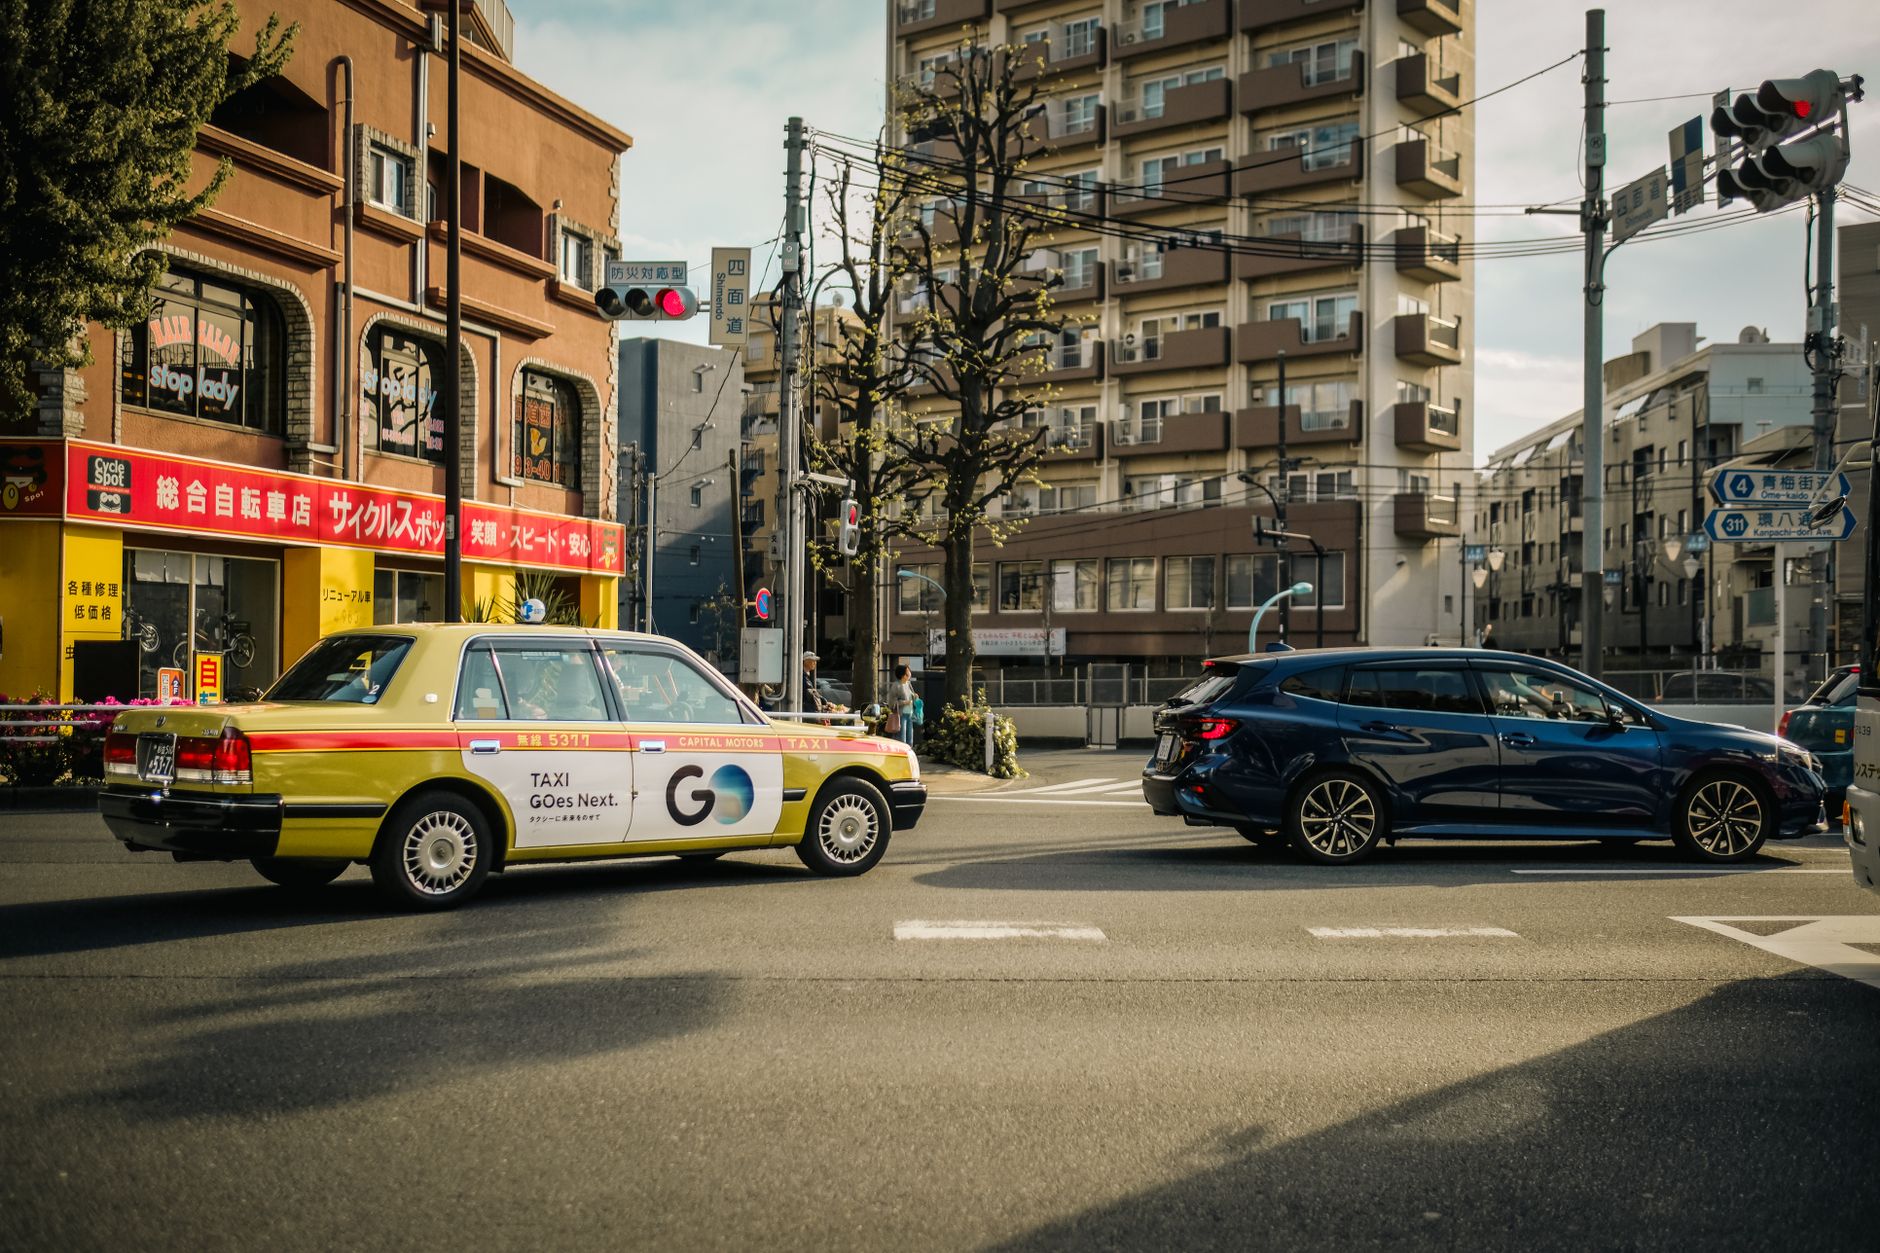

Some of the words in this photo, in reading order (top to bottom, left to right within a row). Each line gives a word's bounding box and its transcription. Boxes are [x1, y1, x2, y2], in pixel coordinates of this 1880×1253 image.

[611, 266, 684, 281] 防災対応型
[715, 272, 726, 321] Shimendo
[726, 259, 745, 335] 四面道
[149, 315, 192, 349] HAIR
[149, 363, 193, 401] stop
[198, 367, 239, 411] lady
[94, 457, 125, 473] Cycle
[94, 469, 125, 487] Spot
[1762, 475, 1832, 491] 青梅街道
[1736, 479, 1748, 495] 4
[24, 490, 44, 503] Spot
[156, 475, 312, 527] 総合自転車店
[328, 490, 446, 547] サイクルスポッ
[470, 518, 592, 558] 笑顔・スピード・安心
[1726, 517, 1745, 532] 311
[1757, 511, 1834, 528] 環八通
[1753, 528, 1813, 540] Kanpachi-dori
[1816, 527, 1834, 537] Ave.
[68, 580, 119, 598] 各種修理
[322, 588, 372, 604] リニューアル車
[74, 604, 112, 621] 低価格
[517, 734, 542, 747] 無線
[548, 734, 590, 747] 5377
[679, 736, 722, 748] CAPITAL
[725, 737, 764, 748] MOTORS
[787, 738, 829, 750] TAXI
[530, 772, 569, 787] TAXI
[530, 794, 573, 808] GOes
[577, 792, 618, 807] Next.
